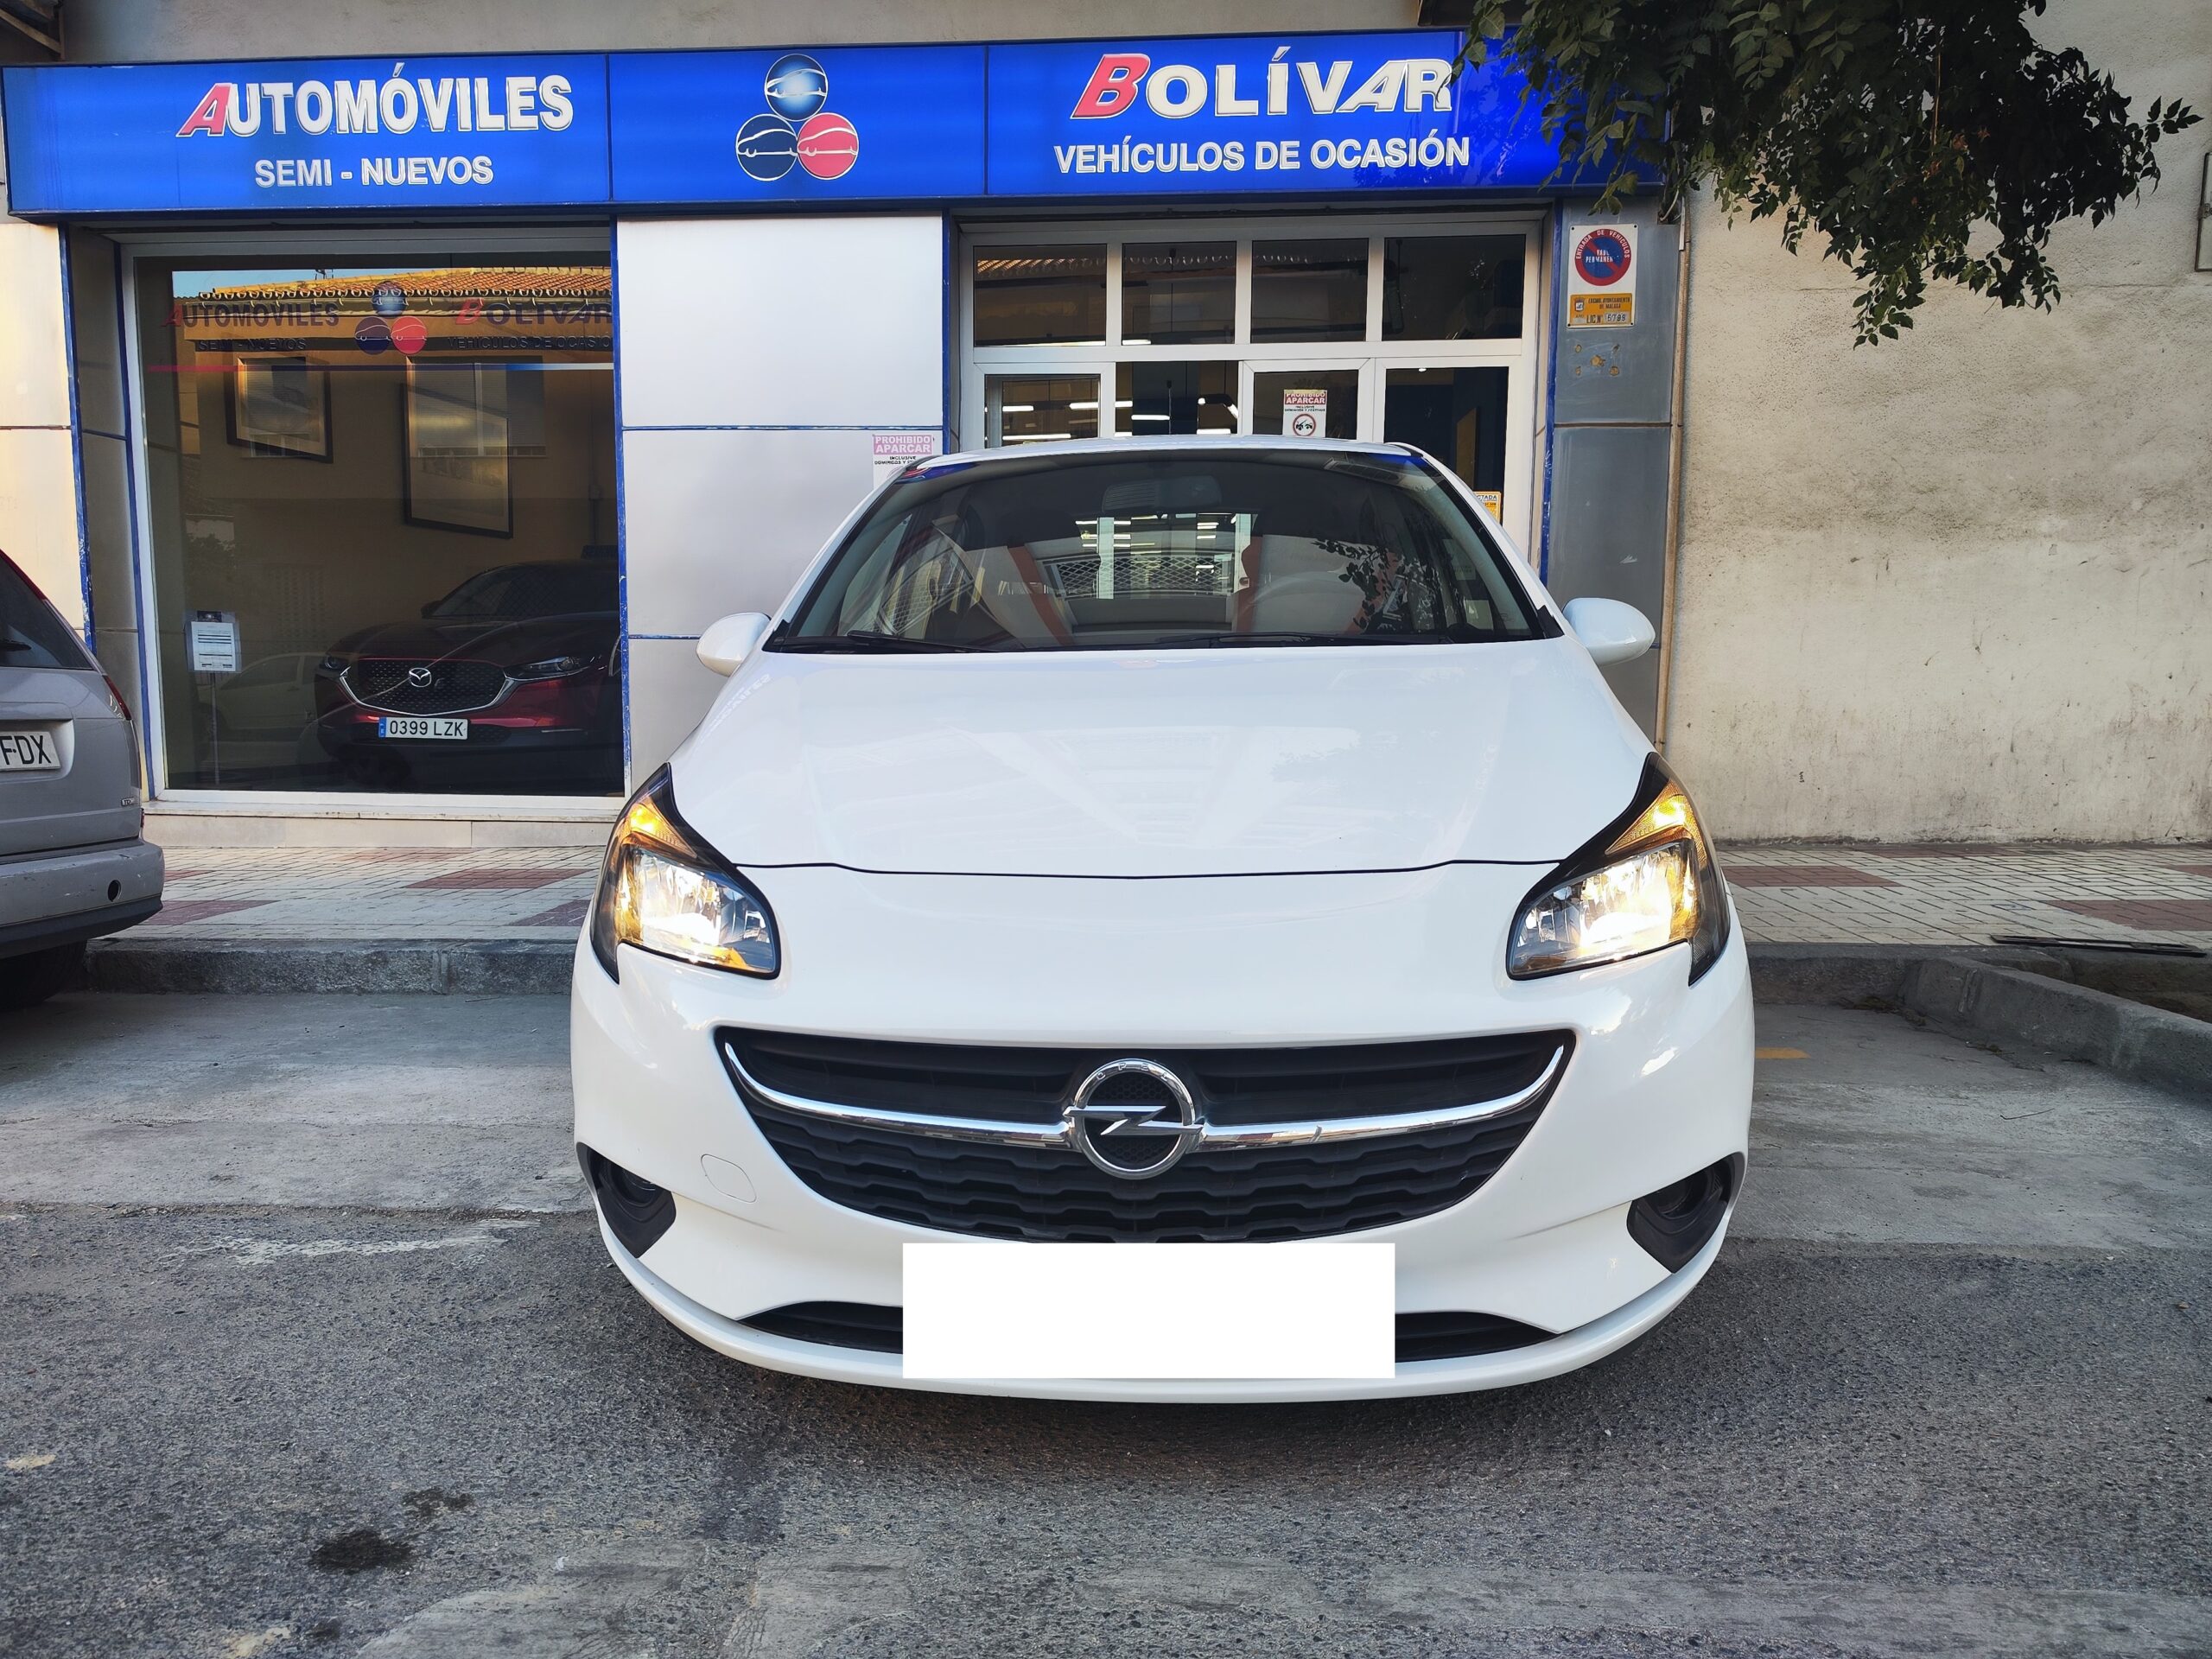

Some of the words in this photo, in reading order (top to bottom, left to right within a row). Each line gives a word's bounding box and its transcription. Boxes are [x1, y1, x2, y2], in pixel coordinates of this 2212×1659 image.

[1070, 46, 1453, 119] BOLÍVAR
[175, 62, 574, 137] AUTOMÓVILES
[1053, 136, 1245, 174] VEHÍCULOS
[1255, 141, 1300, 170] DE
[1310, 129, 1471, 169] OCASIÓN
[255, 158, 332, 188] SEMI
[361, 156, 494, 186] NUEVOS
[1576, 234, 1592, 259] ENTRADA
[1609, 230, 1630, 258] VEHICULOS
[557, 335, 613, 348] OCASIO
[875, 435, 931, 444] PROHIBIDO
[875, 444, 931, 453] APARCAR
[390, 721, 428, 735] 0399
[434, 721, 463, 736] LZK
[0, 735, 52, 765] FDX
[1096, 1062, 1169, 1082] OPEL
